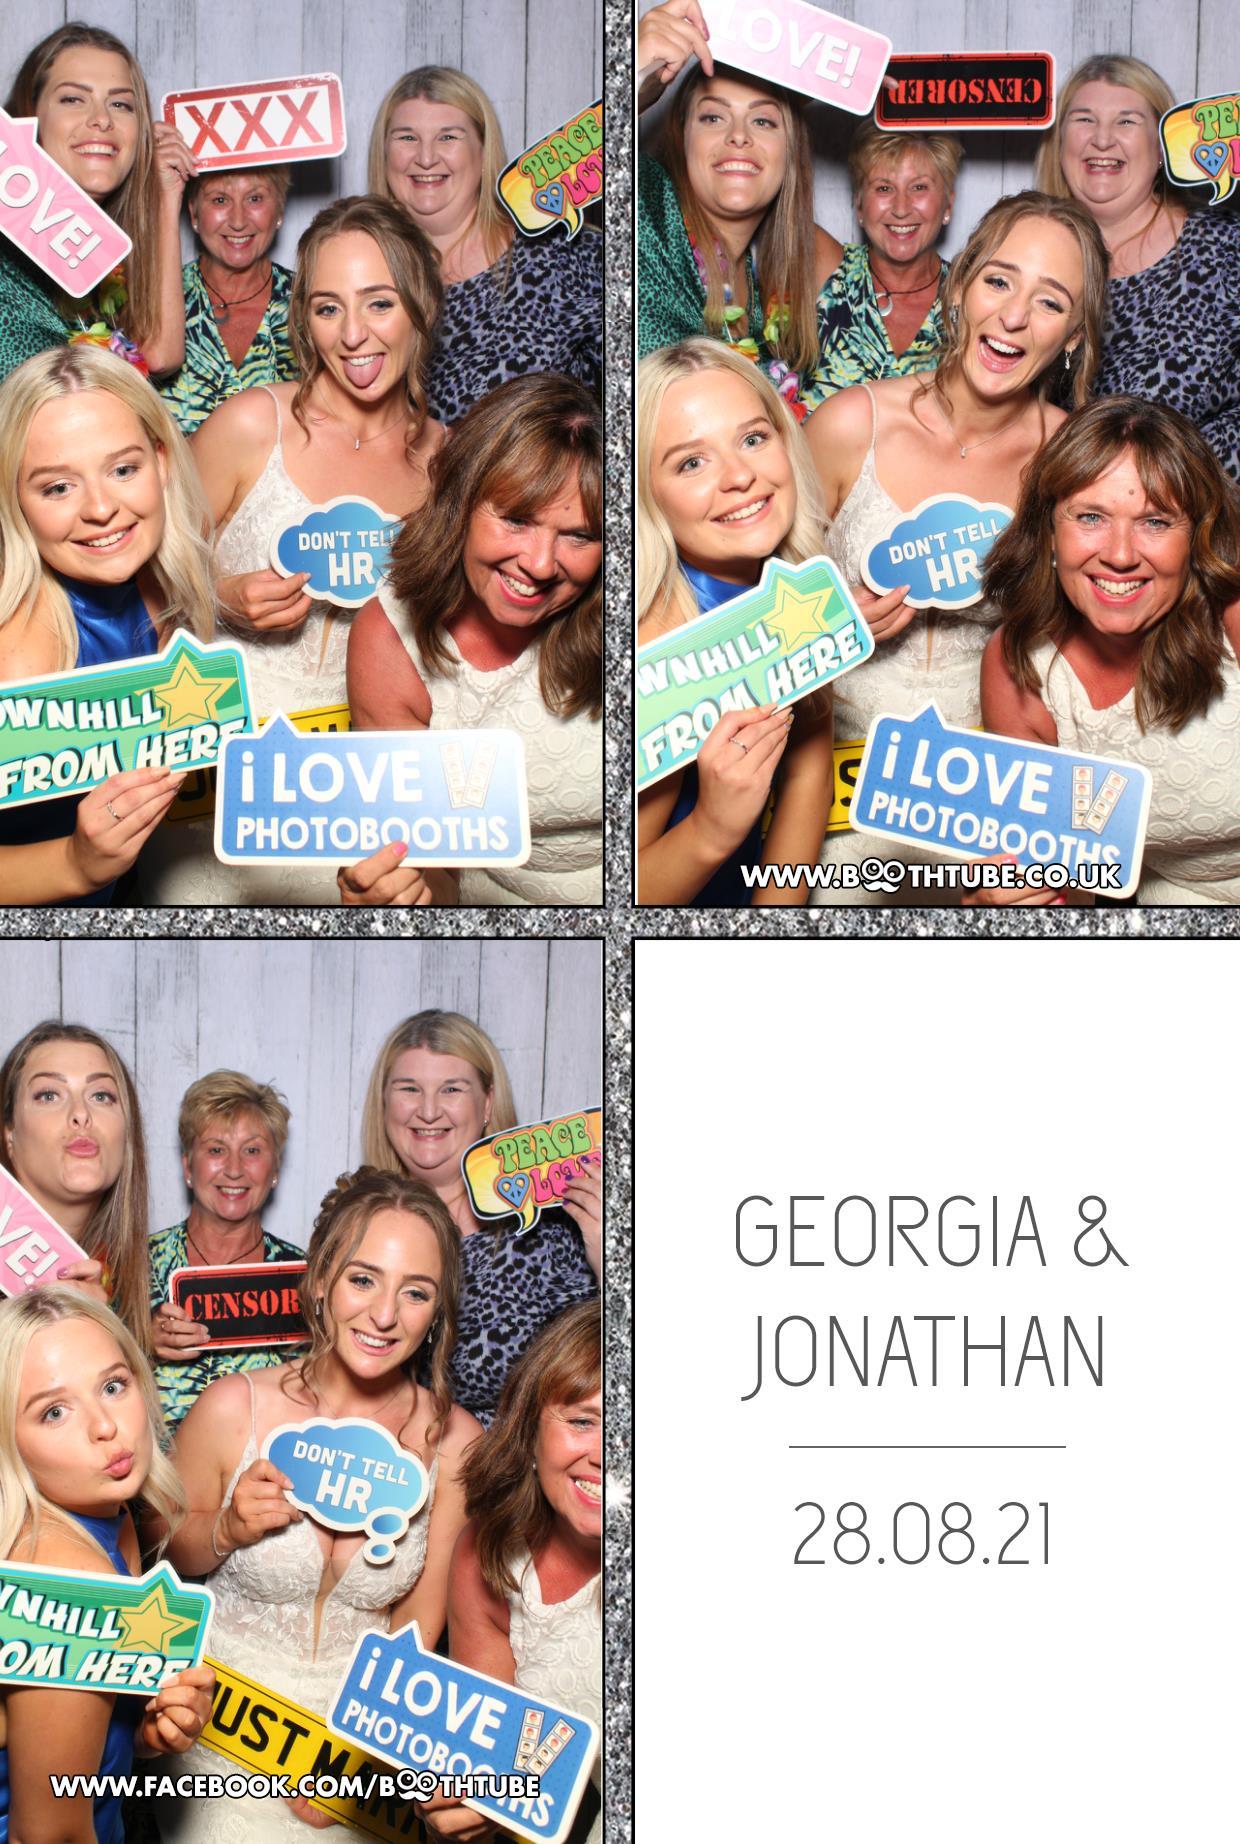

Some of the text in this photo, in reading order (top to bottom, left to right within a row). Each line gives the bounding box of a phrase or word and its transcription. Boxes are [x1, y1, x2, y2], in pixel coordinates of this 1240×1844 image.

[184, 90, 325, 156] XXX
[0, 141, 102, 269] OVE!
[299, 531, 351, 551] DON'T
[888, 518, 1002, 565] DON'T TELL
[328, 552, 376, 587] HR
[925, 547, 984, 592] HR
[767, 621, 863, 704] HERE
[0, 691, 163, 730] WNHILL
[273, 752, 422, 803] LOVE
[910, 739, 1053, 815] LOVE
[236, 815, 510, 851] PHOTOBOOTHS
[494, 1116, 592, 1174] PEACE
[293, 1440, 409, 1486] DON'T TELL
[315, 1469, 373, 1514] HR
[381, 1658, 507, 1750] LOVE
